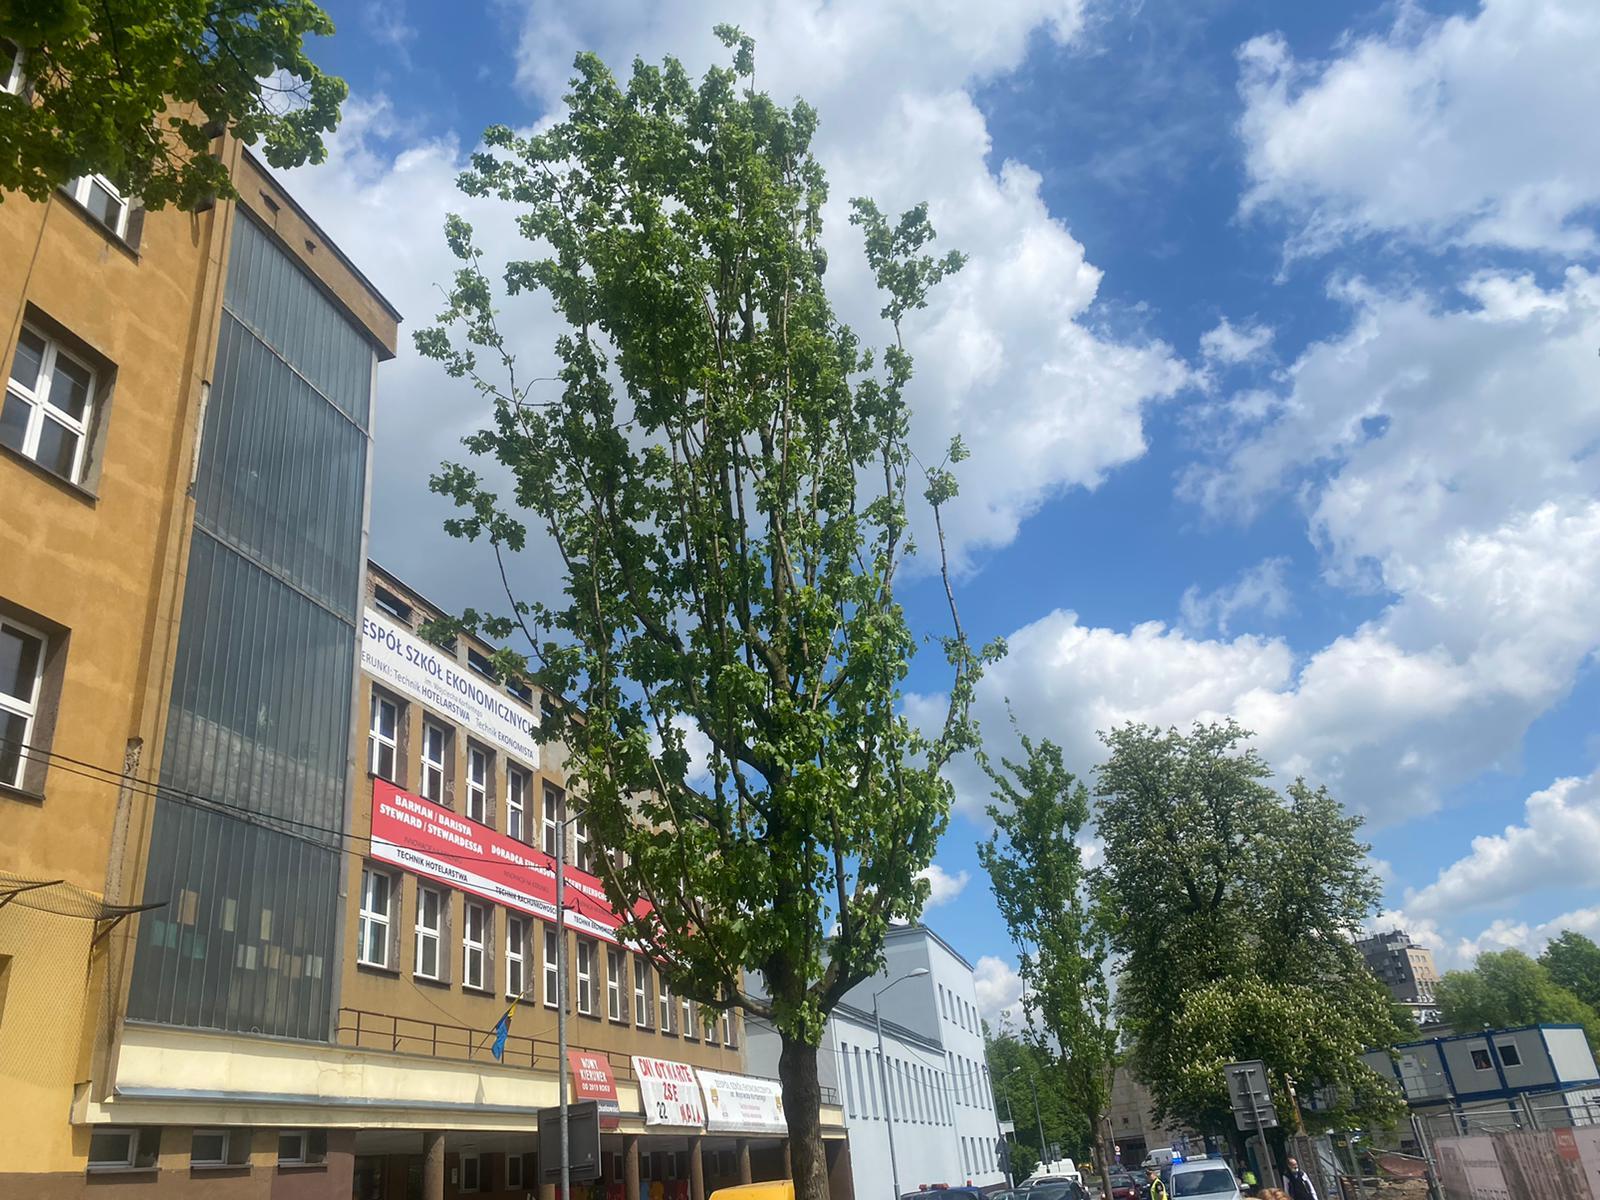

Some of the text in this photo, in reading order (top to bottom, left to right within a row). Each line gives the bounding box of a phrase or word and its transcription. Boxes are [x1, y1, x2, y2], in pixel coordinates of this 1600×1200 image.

[406, 645, 443, 681] SZKÓŁ
[446, 669, 534, 736] EKONOMICZNYCH
[394, 669, 421, 691] Technik
[422, 685, 470, 722] HOTELARSTWA
[476, 717, 498, 738] Technik
[498, 731, 533, 759] EKONOMISTA
[379, 803, 422, 829] STEWARD
[427, 823, 483, 854] STEWARDESSA
[395, 795, 433, 820] BARMAN
[438, 814, 472, 837] BARISTA
[397, 849, 424, 866] TECHNIK
[425, 859, 468, 882] HOTELARSTWA
[491, 844, 524, 866] DORADCA
[495, 886, 517, 900] TECHNIK
[654, 1061, 693, 1083] OTWARTE
[657, 1101, 668, 1119] 22
